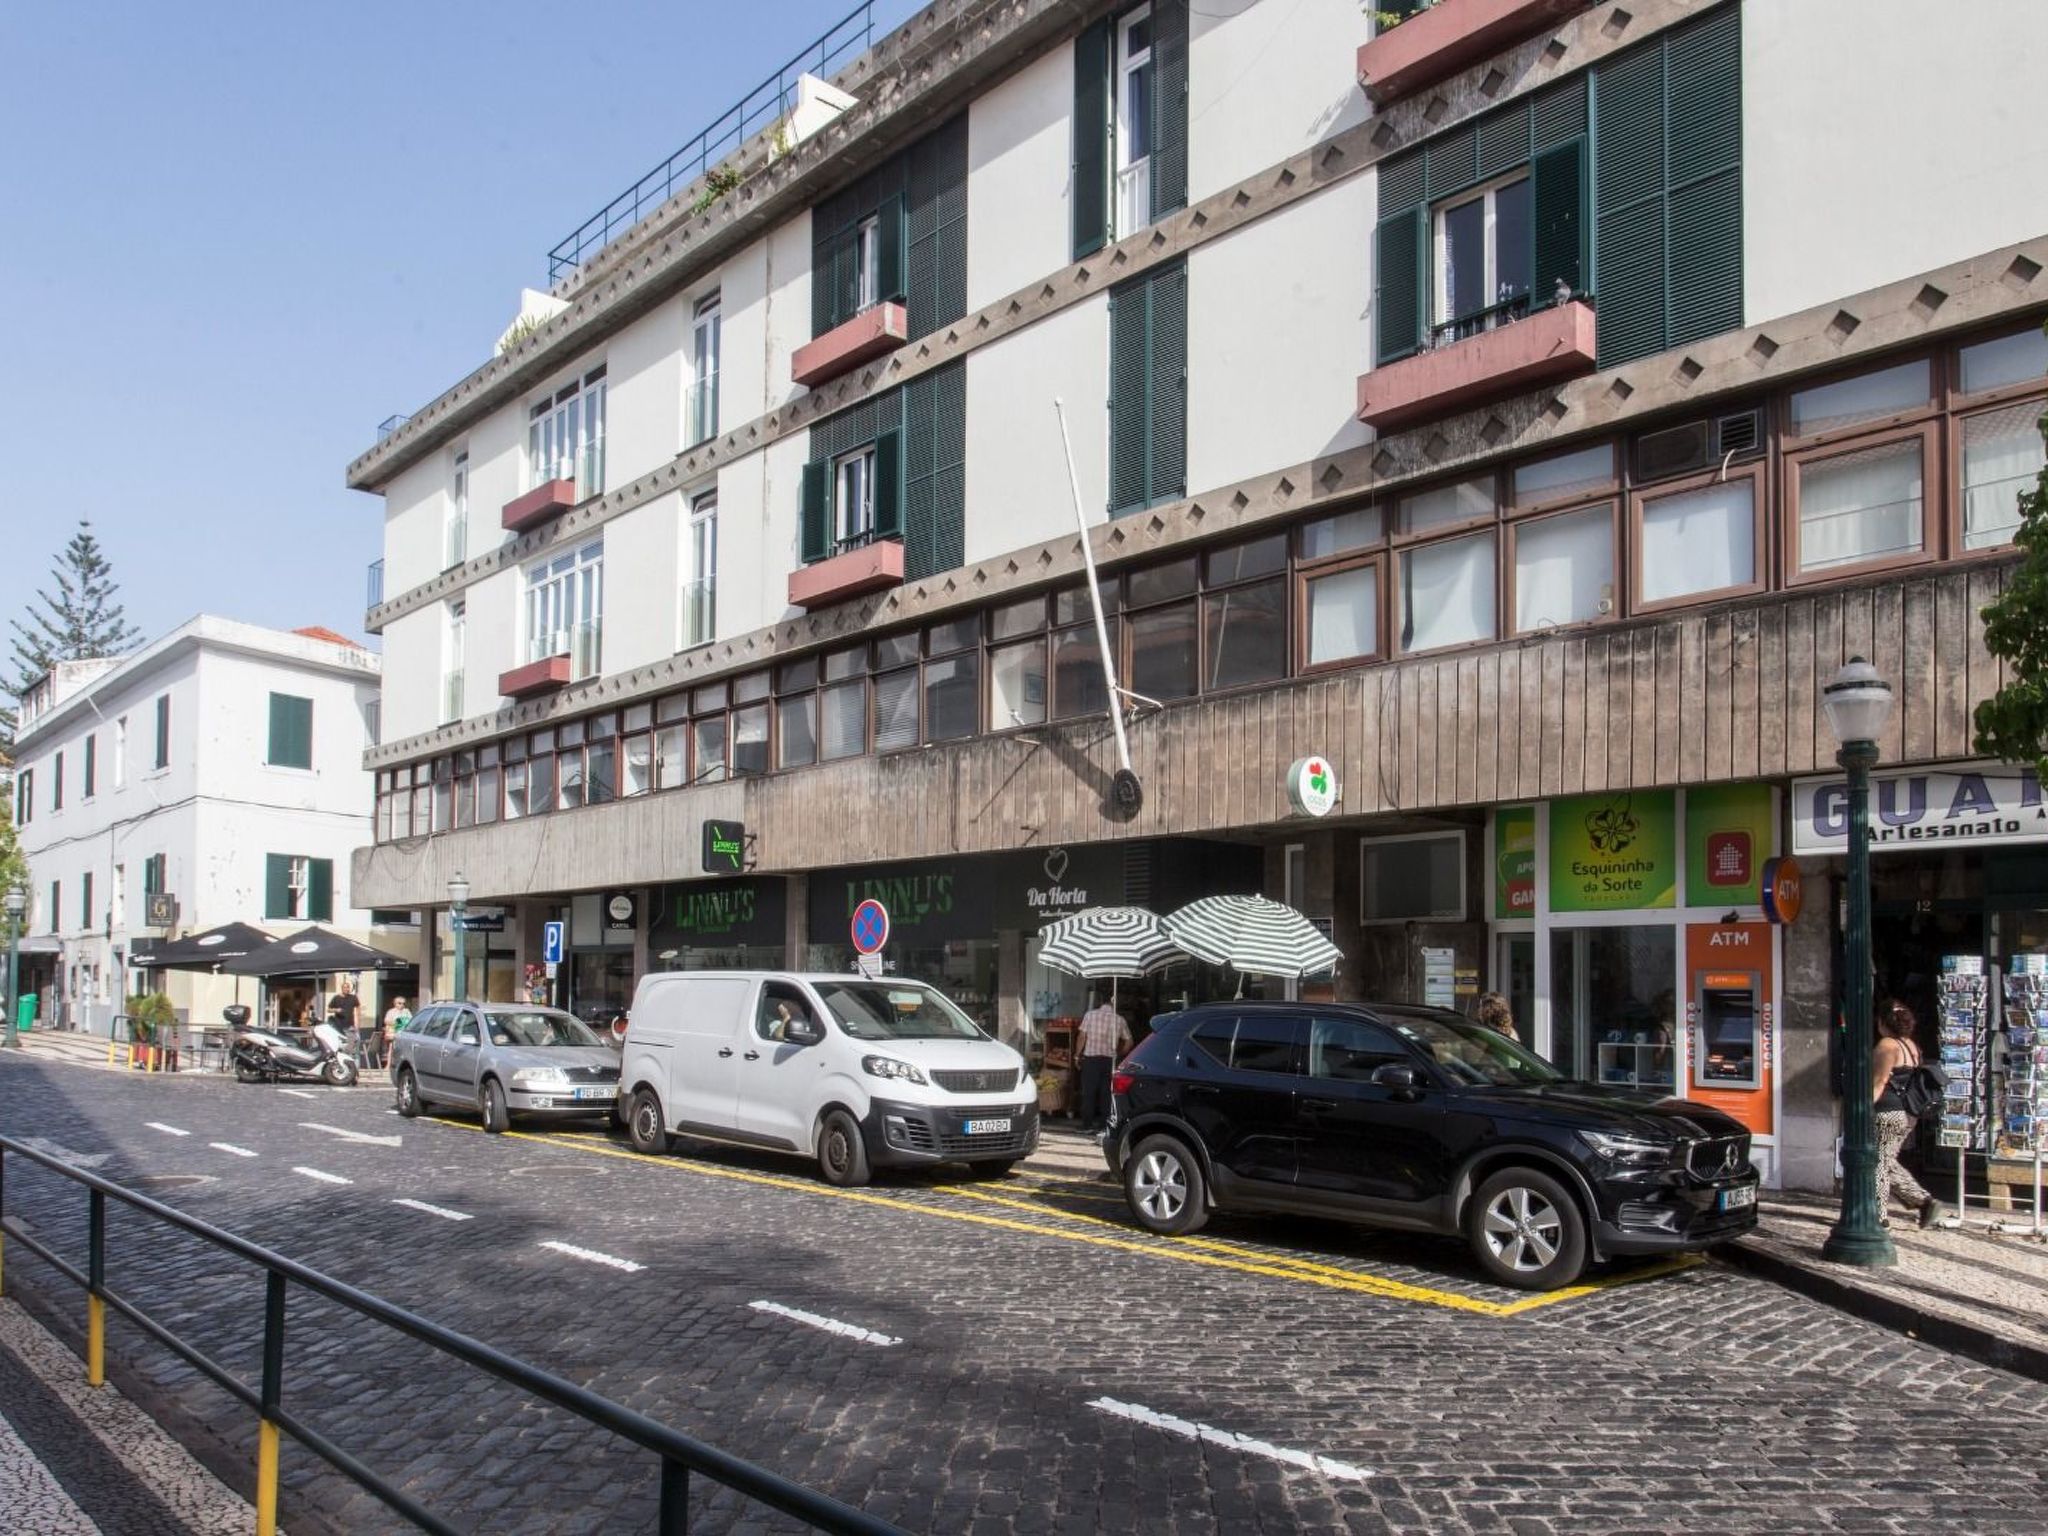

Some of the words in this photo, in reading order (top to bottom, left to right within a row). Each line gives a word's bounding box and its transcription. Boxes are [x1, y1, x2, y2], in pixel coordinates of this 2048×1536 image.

[1867, 817, 2020, 842] Artesanato
[1572, 859, 1654, 878] Esquininha
[1583, 881, 1598, 893] da
[1602, 877, 1643, 892] Sorte
[1779, 879, 1800, 900] ATM
[1027, 887, 1047, 906] Da
[1048, 886, 1087, 905] Horta
[1709, 932, 1750, 946] ATM
